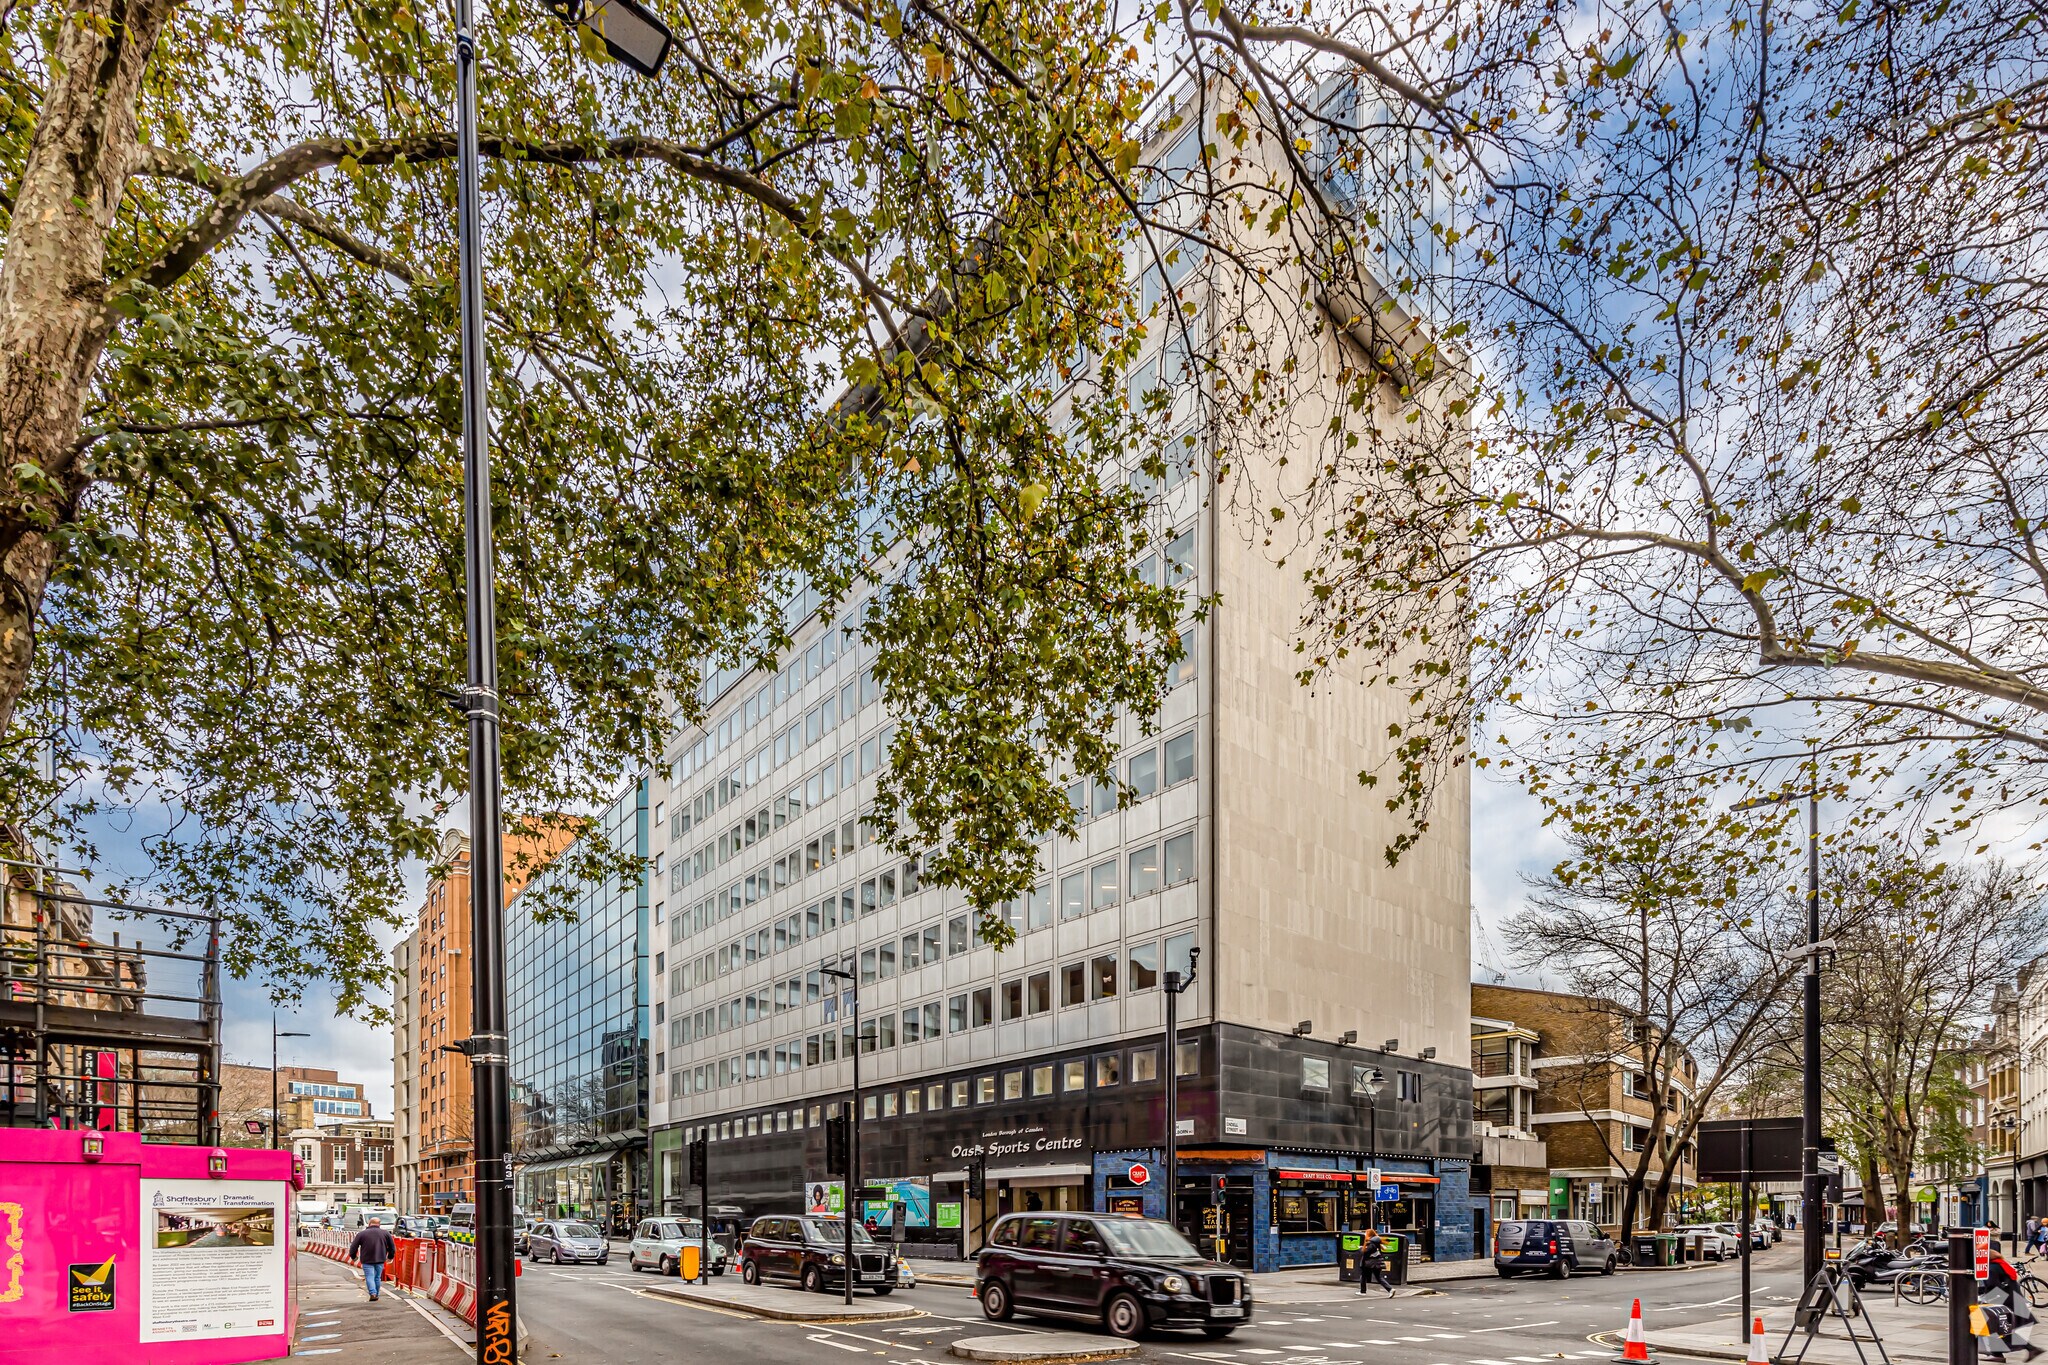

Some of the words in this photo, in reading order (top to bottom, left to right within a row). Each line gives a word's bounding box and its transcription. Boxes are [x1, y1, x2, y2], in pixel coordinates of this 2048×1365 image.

[988, 1142, 1031, 1157] Sports
[1035, 1137, 1083, 1151] Centre
[166, 1195, 217, 1203] Shaftesbury
[1976, 1235, 1988, 1244] LOOK
[1976, 1249, 1988, 1258] BOTH
[1976, 1263, 1988, 1272] WAYS
[72, 1286, 91, 1294] See
[72, 1292, 112, 1303] safely
